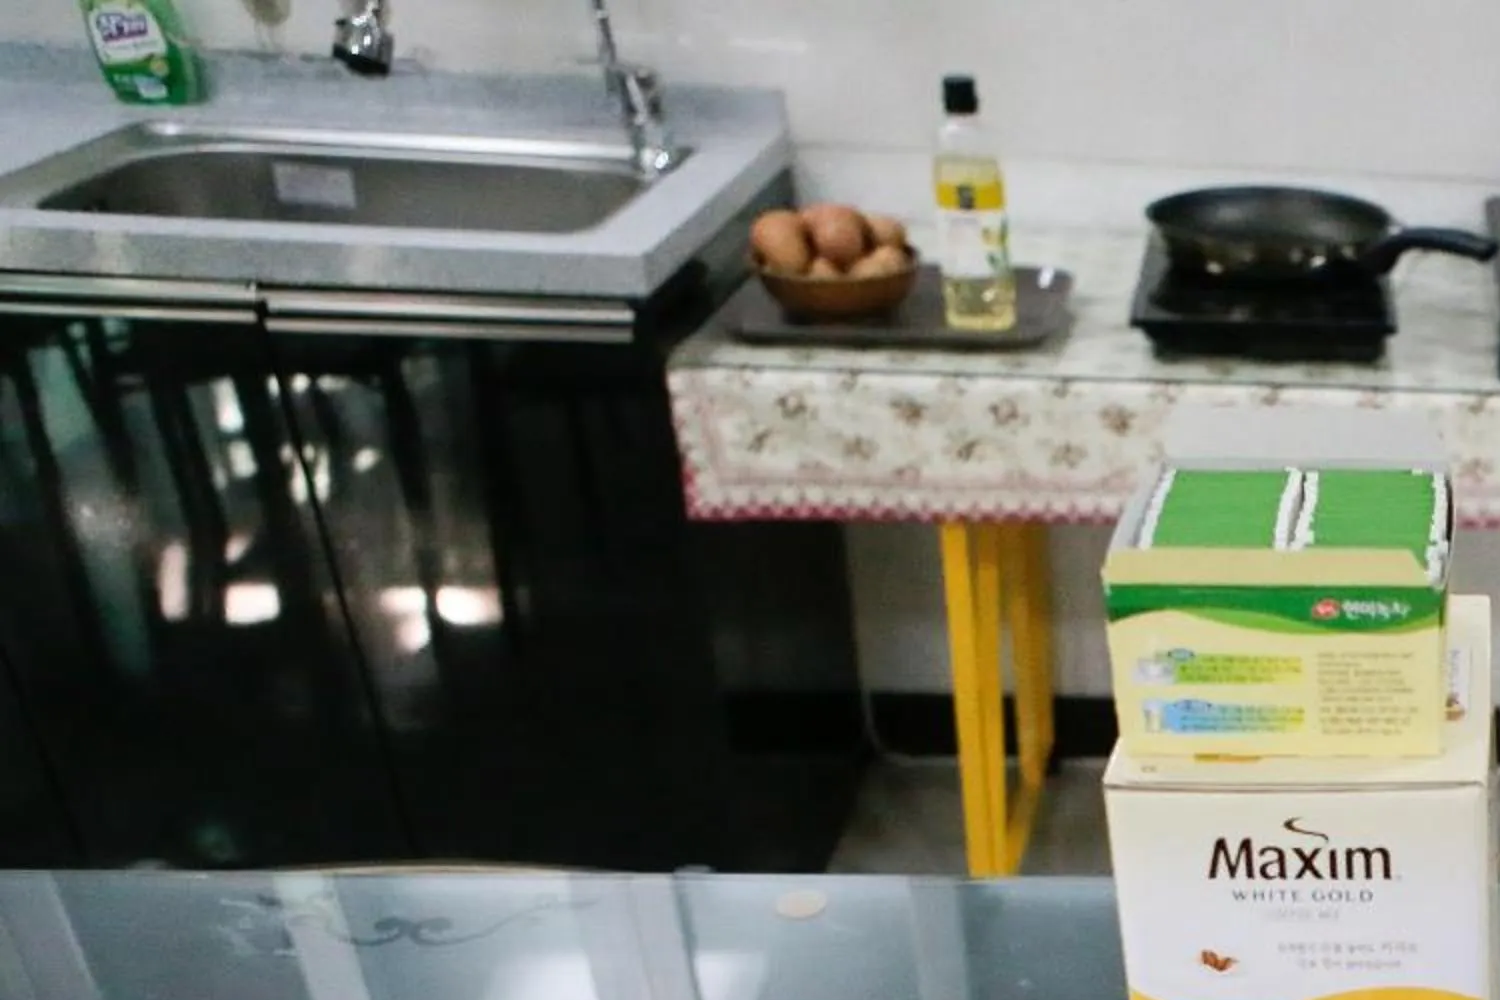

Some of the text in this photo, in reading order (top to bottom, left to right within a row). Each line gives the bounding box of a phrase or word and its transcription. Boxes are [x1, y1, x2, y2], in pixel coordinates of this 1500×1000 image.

[1208, 836, 1393, 881] Maxim
[1231, 888, 1375, 903] WHITE GOLD
